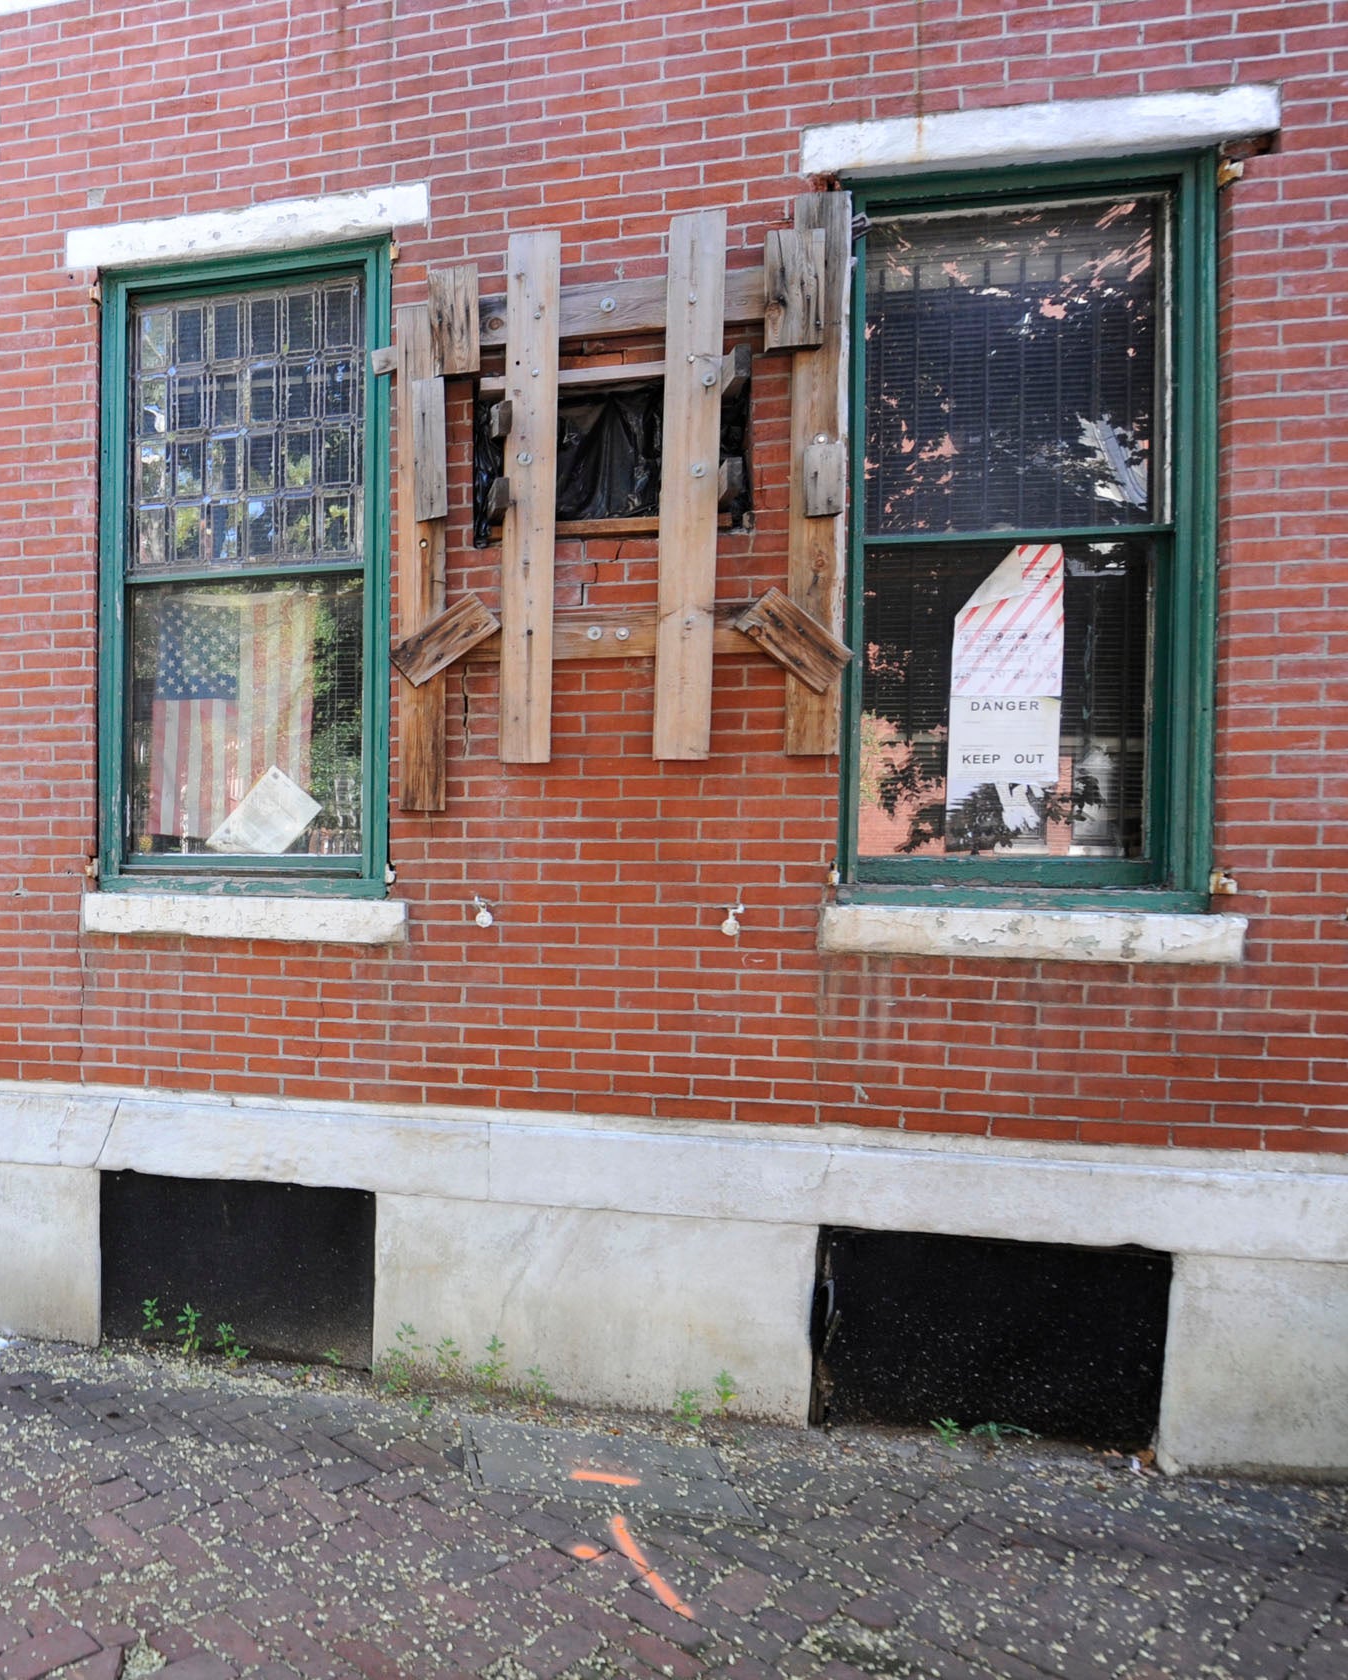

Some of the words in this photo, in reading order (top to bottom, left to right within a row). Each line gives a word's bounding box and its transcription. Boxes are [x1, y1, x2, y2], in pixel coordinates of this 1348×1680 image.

[970, 700, 1040, 712] DANGER
[961, 753, 1002, 765] KEEP
[1013, 753, 1045, 765] OUT
